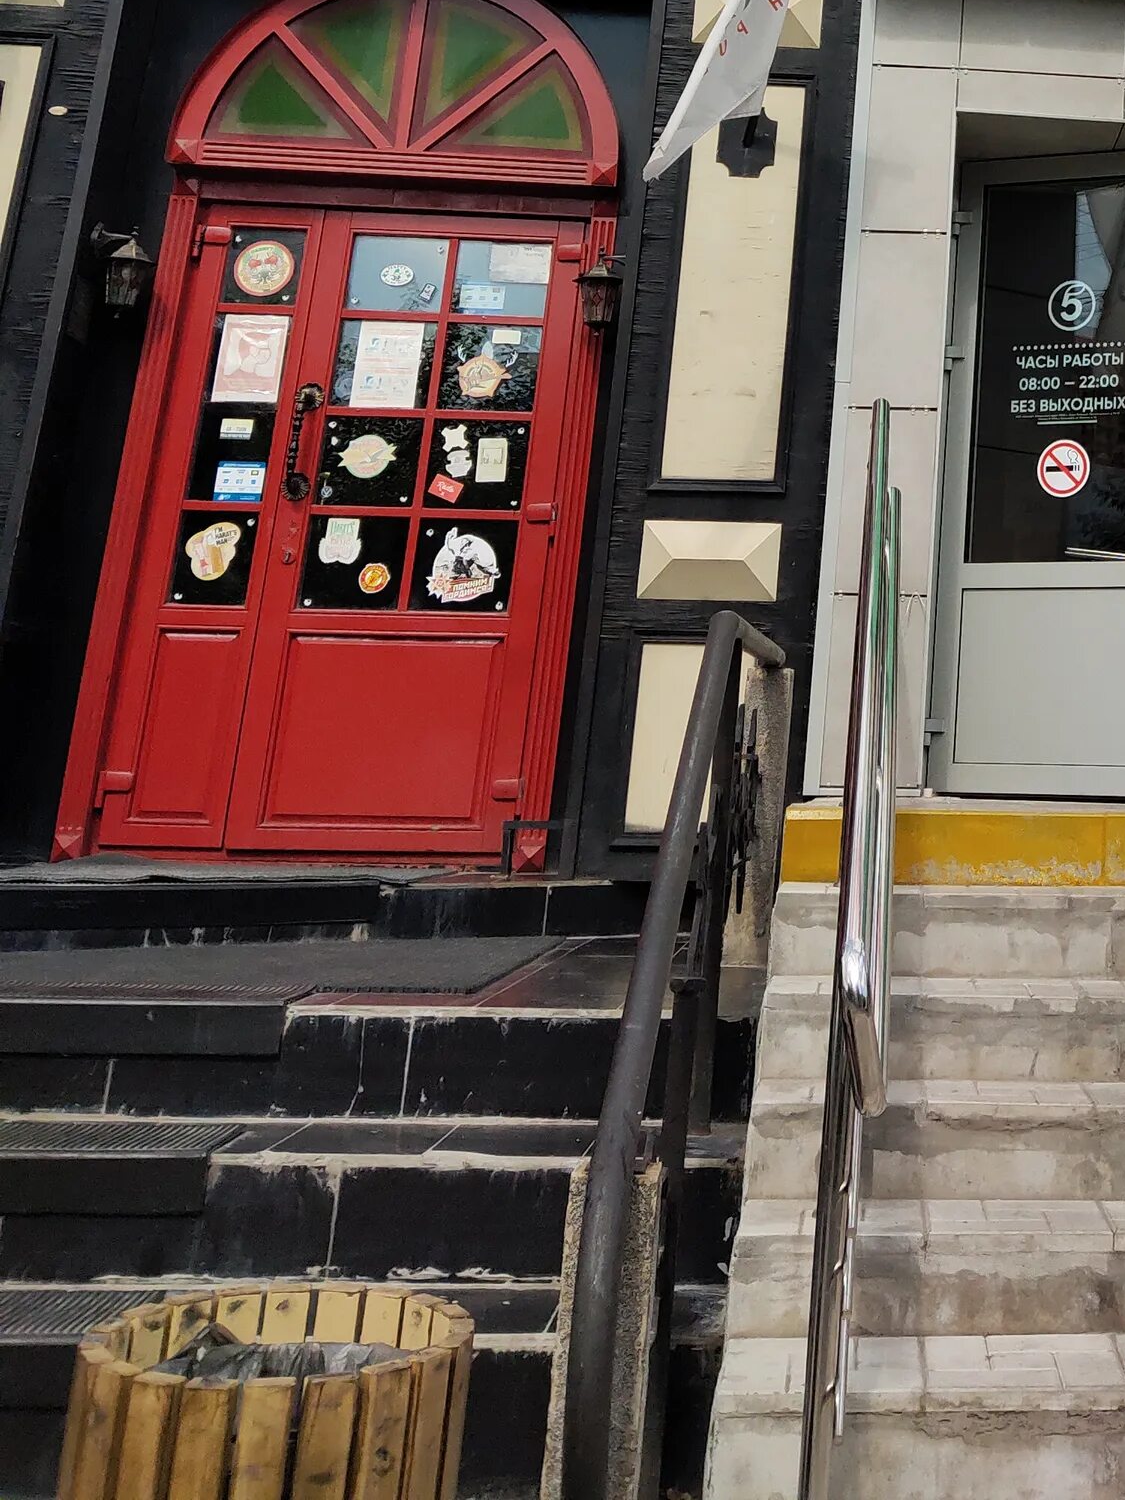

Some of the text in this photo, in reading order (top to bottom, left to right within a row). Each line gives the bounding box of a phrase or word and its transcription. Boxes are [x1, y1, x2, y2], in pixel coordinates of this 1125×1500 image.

[1016, 352, 1124, 369] ЧАСЫ РАБОТЫ
[1018, 376, 1061, 391] 08:00
[1078, 374, 1120, 389] 22:00
[1010, 400, 1036, 413] БЕЗ
